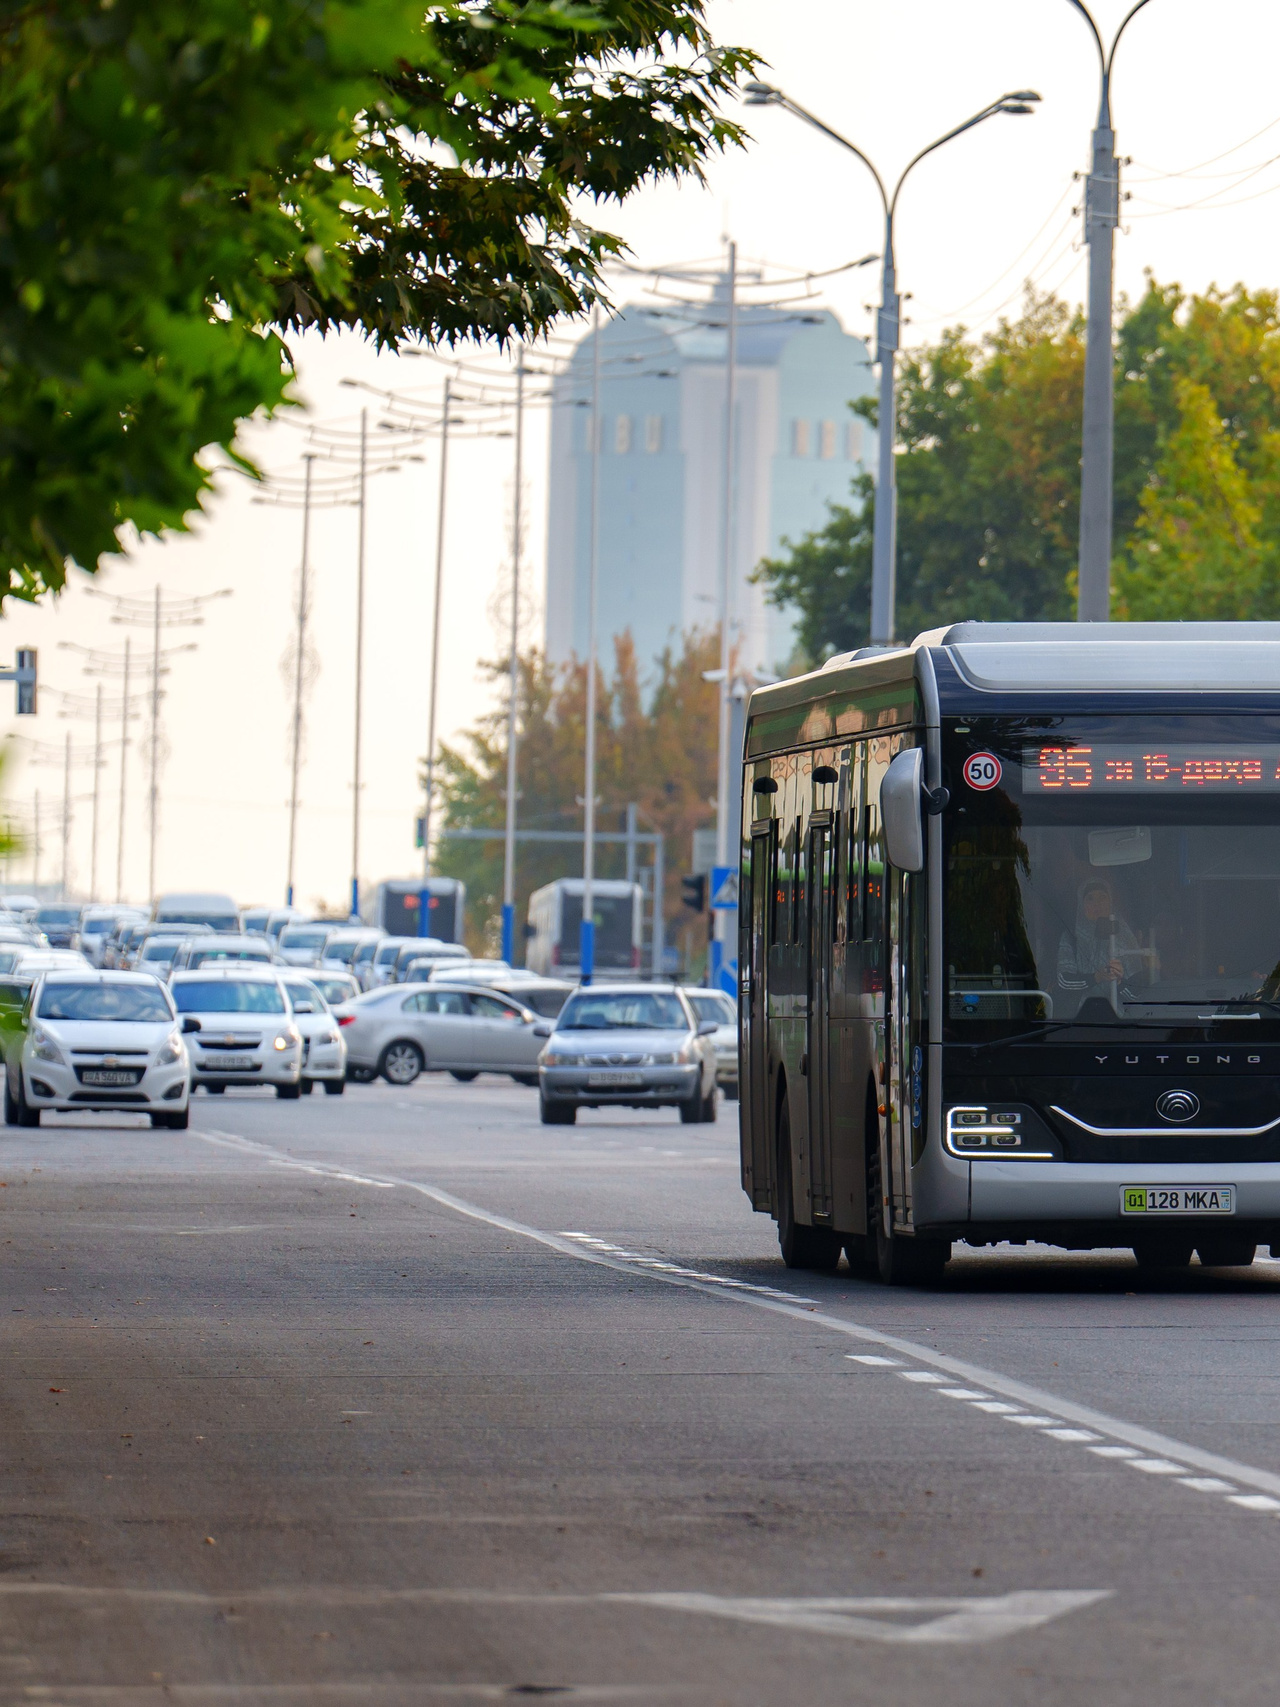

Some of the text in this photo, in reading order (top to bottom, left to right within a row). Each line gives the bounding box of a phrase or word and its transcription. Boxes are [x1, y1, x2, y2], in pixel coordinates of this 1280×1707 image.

[970, 762, 995, 780] 50
[1094, 1055, 1261, 1064] YUTONG
[1128, 1191, 1220, 1209] 01 128 MKA
